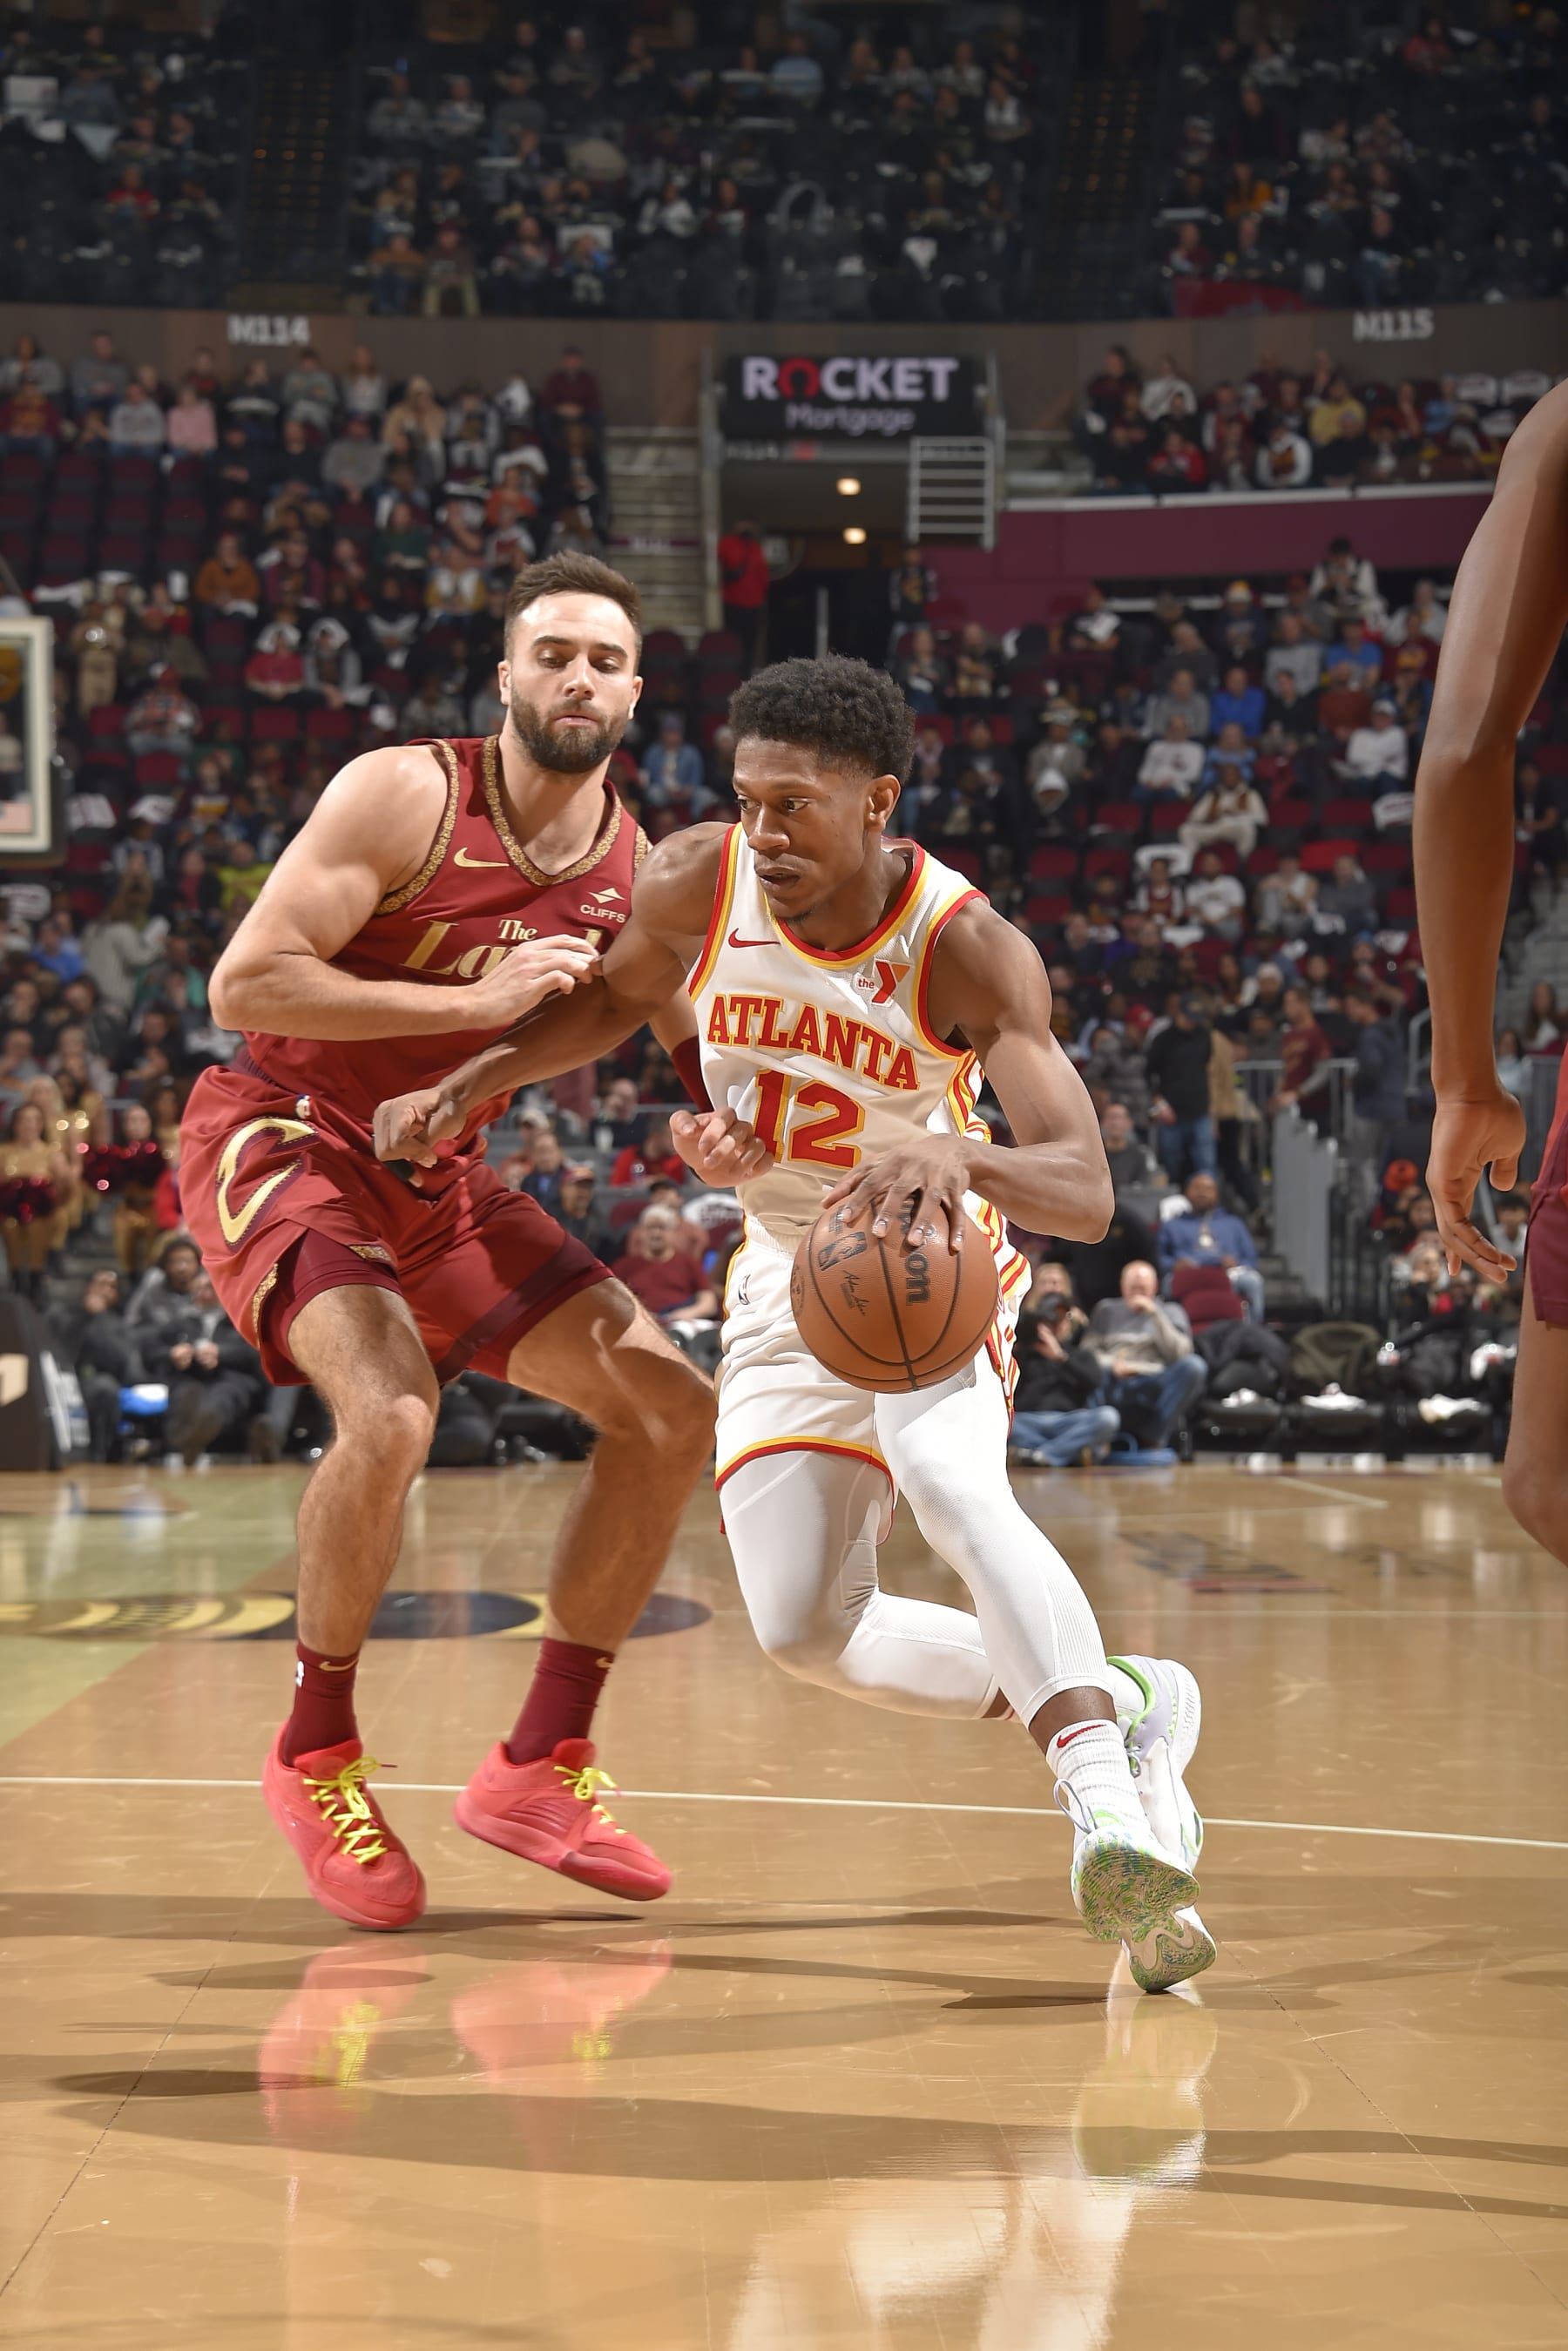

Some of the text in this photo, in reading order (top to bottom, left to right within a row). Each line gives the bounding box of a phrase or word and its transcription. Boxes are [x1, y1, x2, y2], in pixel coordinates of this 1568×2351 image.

[742, 355, 959, 401] ROCKET
[785, 404, 915, 436] Mortgage
[580, 904, 626, 923] CLIFFS
[497, 919, 537, 941] The
[858, 978, 875, 990] the
[706, 993, 920, 1091] ATLANTA
[754, 1068, 865, 1168] 12
